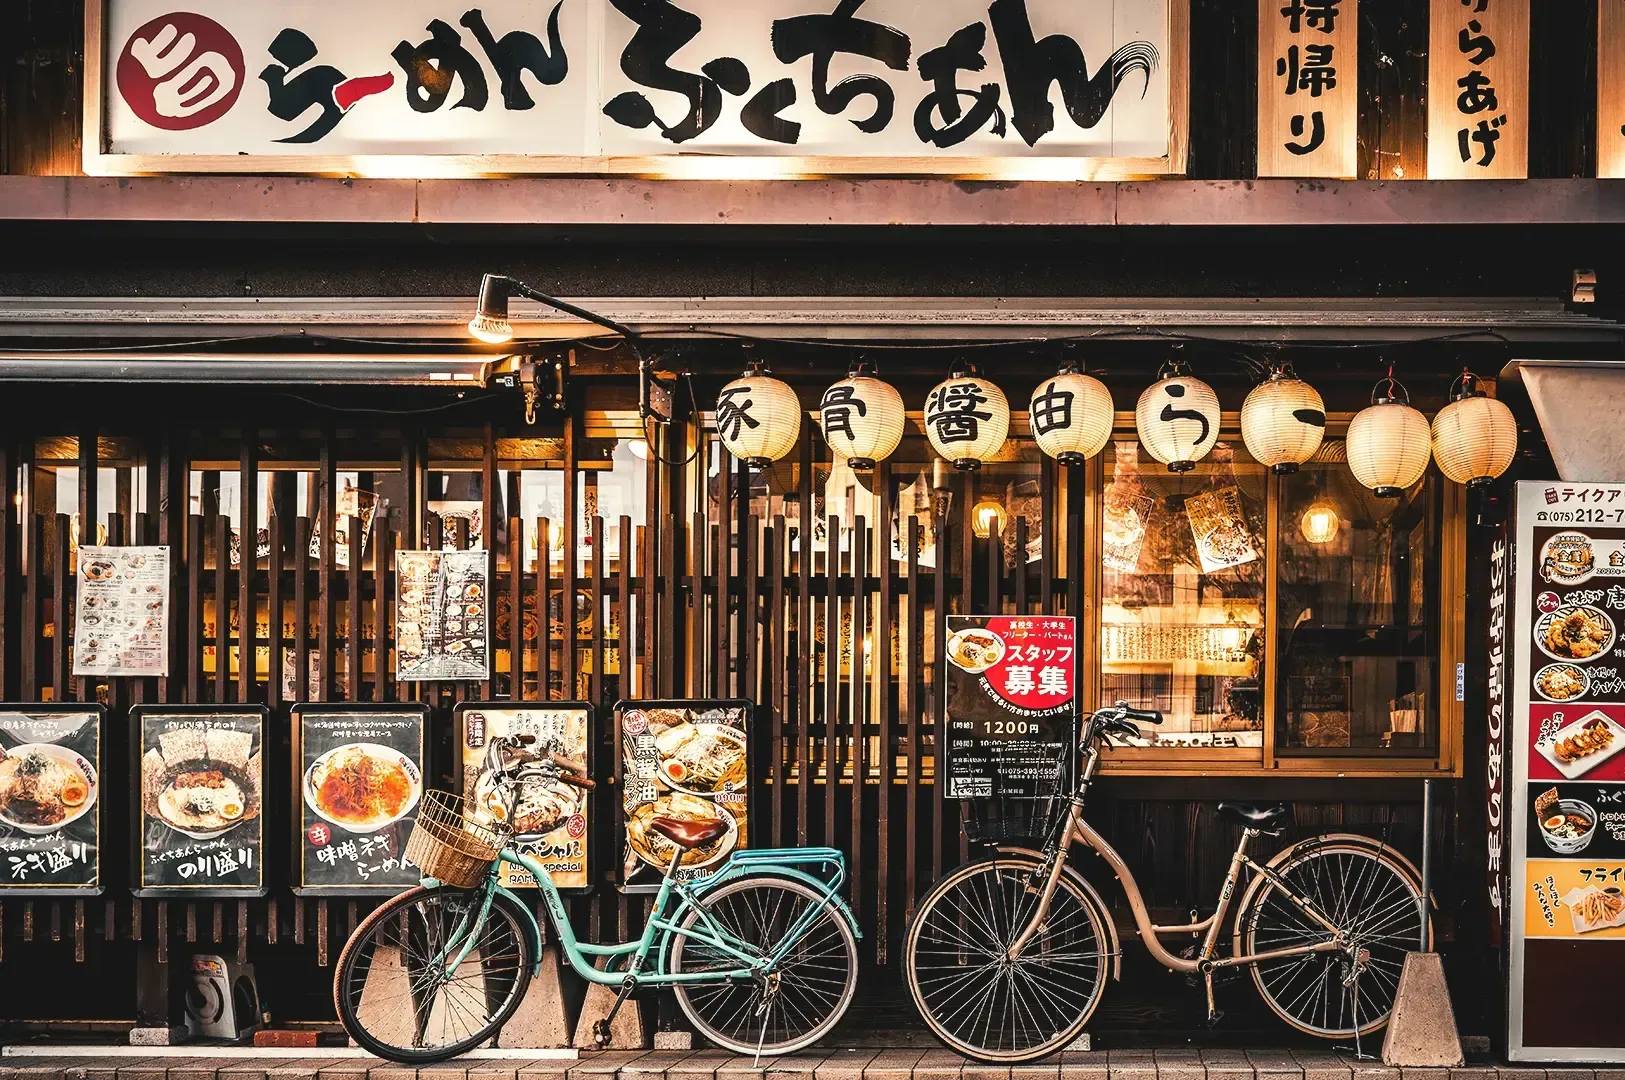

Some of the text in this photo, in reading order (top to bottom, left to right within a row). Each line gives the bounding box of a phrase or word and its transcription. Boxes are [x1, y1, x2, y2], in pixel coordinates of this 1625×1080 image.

[259, 0, 1159, 147] らーめん ふくちあん
[1456, 0, 1507, 167] らあげ
[821, 386, 866, 440] 骨
[1562, 488, 1625, 503] テイクア
[1007, 644, 1073, 662] スタッフ
[1004, 664, 1068, 696] 募集
[1597, 789, 1625, 803] ふく
[150, 838, 229, 865] ふくちあんらーめん
[177, 848, 252, 879] のり盛り
[357, 856, 416, 881] らーめん
[1579, 867, 1625, 882] フライ
